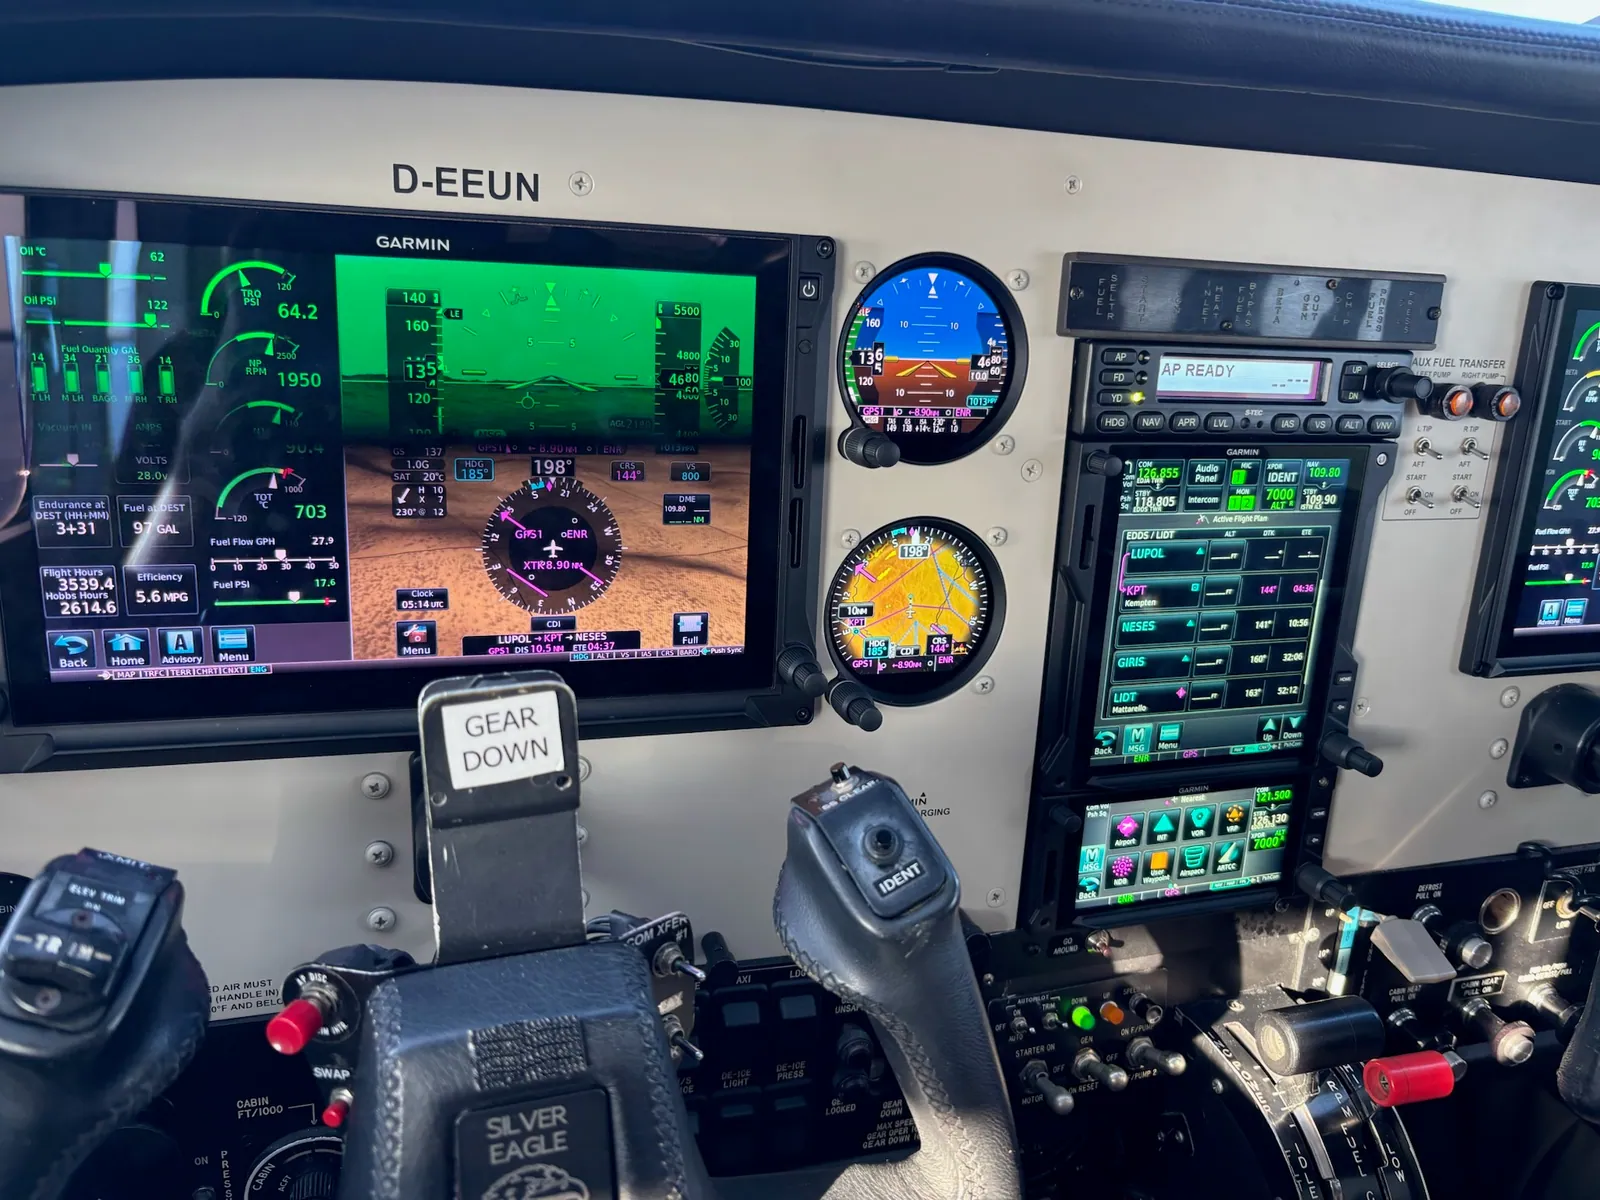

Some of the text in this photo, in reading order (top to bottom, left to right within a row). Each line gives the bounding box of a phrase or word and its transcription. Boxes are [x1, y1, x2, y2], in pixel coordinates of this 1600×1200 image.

[393, 163, 539, 202] D-EEUN
[376, 236, 450, 251] GARMIN
[150, 252, 164, 262] 62
[403, 292, 426, 303] 140
[147, 300, 168, 310] 122
[278, 304, 318, 320] 64.2
[674, 305, 699, 316] 5500
[405, 320, 429, 332] 160
[866, 319, 881, 327] 160
[64, 354, 76, 362] 34
[677, 350, 700, 360] 4800
[1412, 358, 1506, 369] AUX FUEL TRANSFER
[1161, 363, 1235, 378] AP READY
[1352, 366, 1362, 374] UP
[278, 372, 321, 387] 1950
[859, 377, 873, 386] 120
[1113, 374, 1124, 382] FD
[408, 393, 430, 404] 120
[1111, 394, 1122, 402] YD
[863, 407, 971, 416] GPS1 ENR
[1105, 418, 1125, 427] HDG
[1142, 418, 1160, 427] NAV
[1177, 418, 1196, 427] APR
[1213, 419, 1229, 428] LVL
[1281, 420, 1295, 428] IAS
[1315, 420, 1326, 429] VS
[1345, 420, 1360, 429] ALT
[1376, 421, 1392, 430] VNV
[425, 447, 442, 456] 137
[135, 456, 168, 465] VOLTS
[464, 460, 484, 468] HDG
[534, 459, 572, 475] 198°
[1195, 464, 1219, 473] Audio
[681, 472, 699, 481] 800
[1138, 467, 1179, 478] 126.855
[1268, 472, 1298, 482] IDENT
[1309, 467, 1341, 478] 109.80
[1195, 475, 1217, 483] Panel
[1266, 488, 1294, 500] 7000
[1135, 496, 1176, 507] 118.805
[1305, 494, 1337, 505] 109.90
[38, 501, 105, 509] Endurance at
[1271, 501, 1286, 510] ALT
[294, 505, 327, 519] 703
[56, 522, 96, 535] 3+31
[210, 538, 230, 546] Fuel
[233, 538, 253, 546] Flow
[312, 537, 334, 545] 27.9
[903, 546, 928, 557] 198°
[1131, 548, 1165, 559] LUPOL
[137, 573, 183, 583] Efficiency
[314, 578, 336, 587] 17.6
[58, 578, 114, 591] 3539.4
[213, 580, 250, 589] Fuel PSI
[46, 591, 108, 600] Hobbs Hours
[136, 591, 188, 603] 5.6 MPG
[60, 602, 116, 615] 2614.6
[402, 600, 444, 609] 05:14 UTC
[1125, 600, 1156, 609] Kempten
[1122, 621, 1155, 632] NESES
[1289, 618, 1309, 627] 10:56
[498, 632, 607, 644] LUPOL KPT NESES
[682, 636, 699, 644] Full
[869, 640, 885, 648] HDG
[403, 647, 430, 655] Menu
[111, 656, 145, 666] Home
[162, 655, 202, 664] Advisory
[219, 652, 249, 662] Menu
[60, 658, 88, 668] Back
[1117, 657, 1146, 668] GIRIS
[1114, 692, 1137, 703] LIDT
[1112, 705, 1147, 713] Mattarello
[465, 707, 538, 737] GEAR
[1158, 742, 1178, 750] Menu
[463, 737, 548, 772] DOWN
[1134, 755, 1149, 763] ENR
[1256, 790, 1291, 802] 121.500
[1115, 838, 1136, 847] Airport
[1254, 837, 1279, 849] 7000
[878, 862, 922, 893] IDENT
[676, 927, 688, 943] #1
[222, 983, 240, 992] AIR
[243, 980, 272, 989] MUST
[215, 990, 262, 1003] (HANDLE
[1018, 995, 1049, 1003] AUTOPILOT
[231, 1002, 252, 1011] AND
[1080, 1036, 1093, 1044] GEN
[1016, 1046, 1045, 1057] STARTER
[1106, 1053, 1118, 1061] OFF
[313, 1066, 350, 1079] SWAP
[1053, 1064, 1065, 1073] OFF
[777, 1070, 804, 1080] PRESS
[723, 1078, 748, 1088] LIGHT
[1078, 1082, 1099, 1092] RESET
[237, 1097, 269, 1108] CABIN
[1022, 1095, 1044, 1105] MOTOR
[1327, 1080, 1352, 1117] RPM
[238, 1105, 283, 1119] FT/1000
[880, 1108, 903, 1118] DOWN
[486, 1105, 568, 1139] SILVER
[490, 1130, 568, 1165] EAGLE
[1341, 1123, 1367, 1177] FUEL
[194, 1156, 208, 1165] ON
[1387, 1143, 1405, 1182] LOW
[1294, 1143, 1318, 1199] IDLE
[252, 1163, 276, 1191] CABIN
